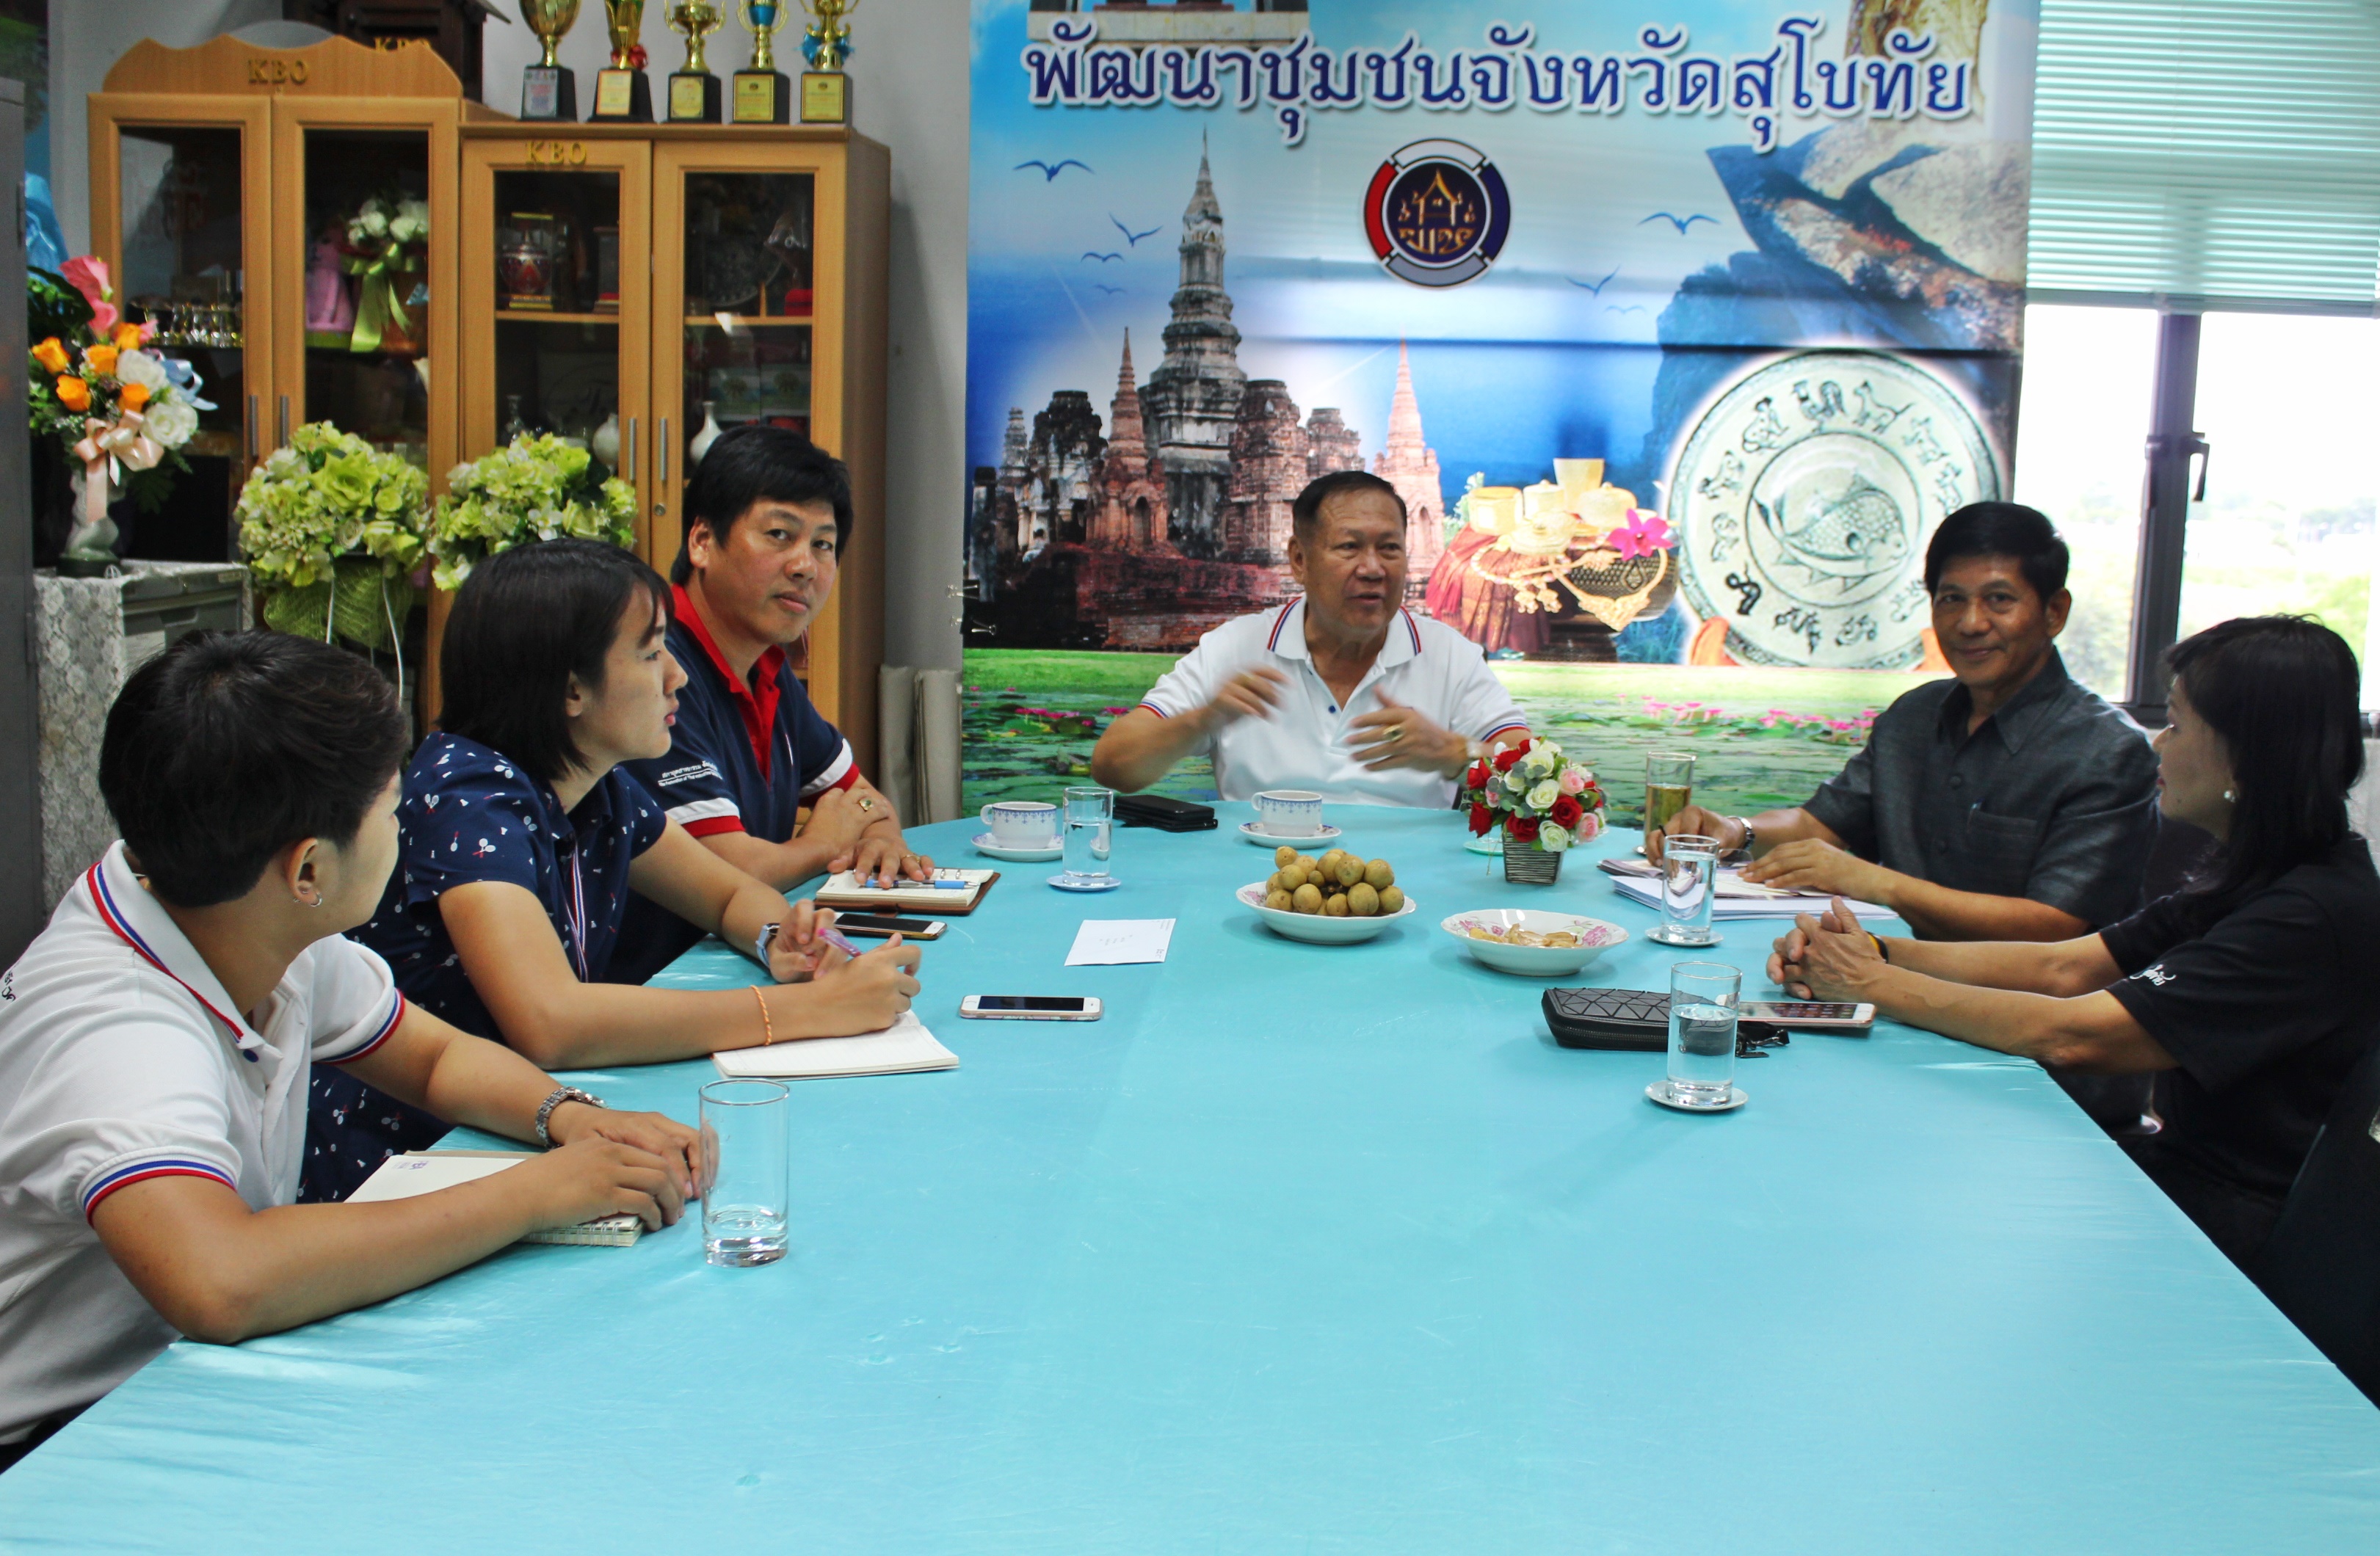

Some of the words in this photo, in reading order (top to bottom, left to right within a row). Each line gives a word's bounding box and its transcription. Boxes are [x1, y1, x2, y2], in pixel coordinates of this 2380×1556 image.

[247, 59, 310, 84] KBO
[1025, 15, 1969, 148] พัฒนาชุมชนจังหวัดสุโขทัย
[525, 140, 587, 166] KBO
